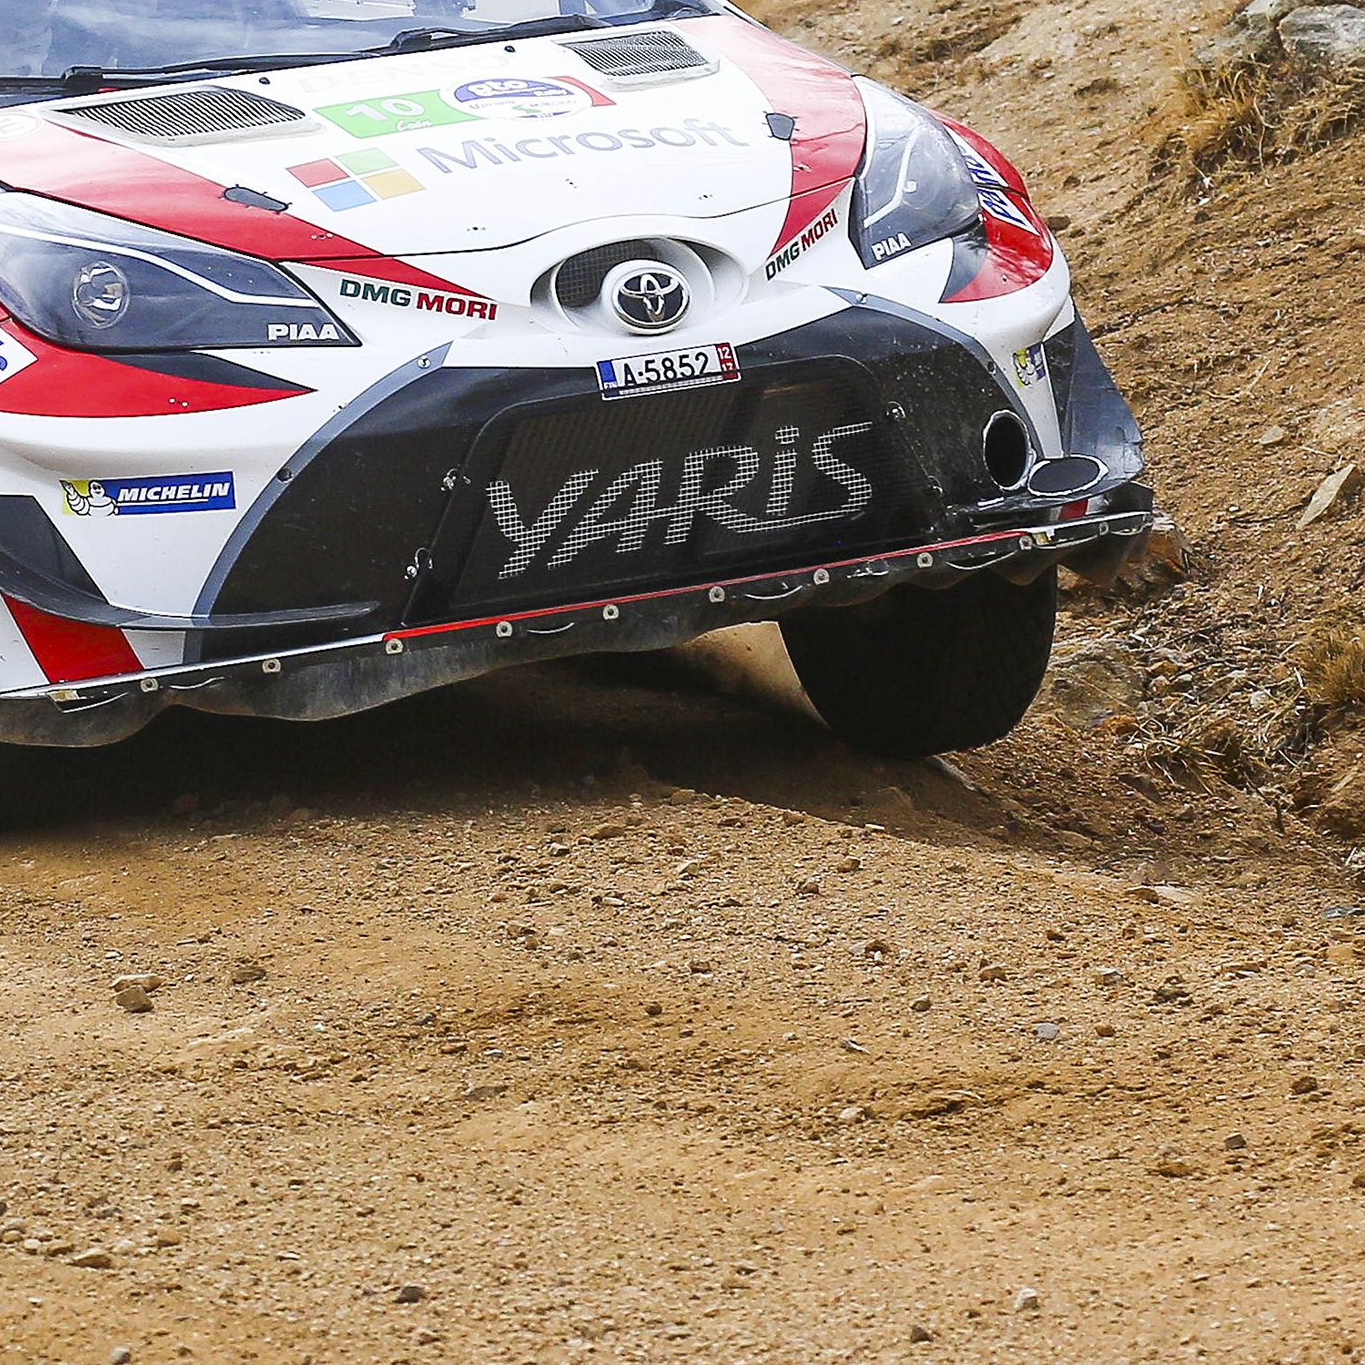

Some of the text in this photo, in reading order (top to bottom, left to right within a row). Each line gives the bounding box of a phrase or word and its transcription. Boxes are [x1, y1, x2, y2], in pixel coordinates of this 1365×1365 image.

[300, 54, 510, 93] DENSO
[346, 98, 425, 122] 10
[415, 117, 750, 174] Microsoft
[765, 208, 838, 281] DMG MORI
[872, 232, 912, 261] PIAA
[340, 278, 498, 322] DMG MORI
[267, 322, 339, 342] PIAA
[718, 346, 732, 359] 12
[116, 481, 231, 503] MICHELIN
